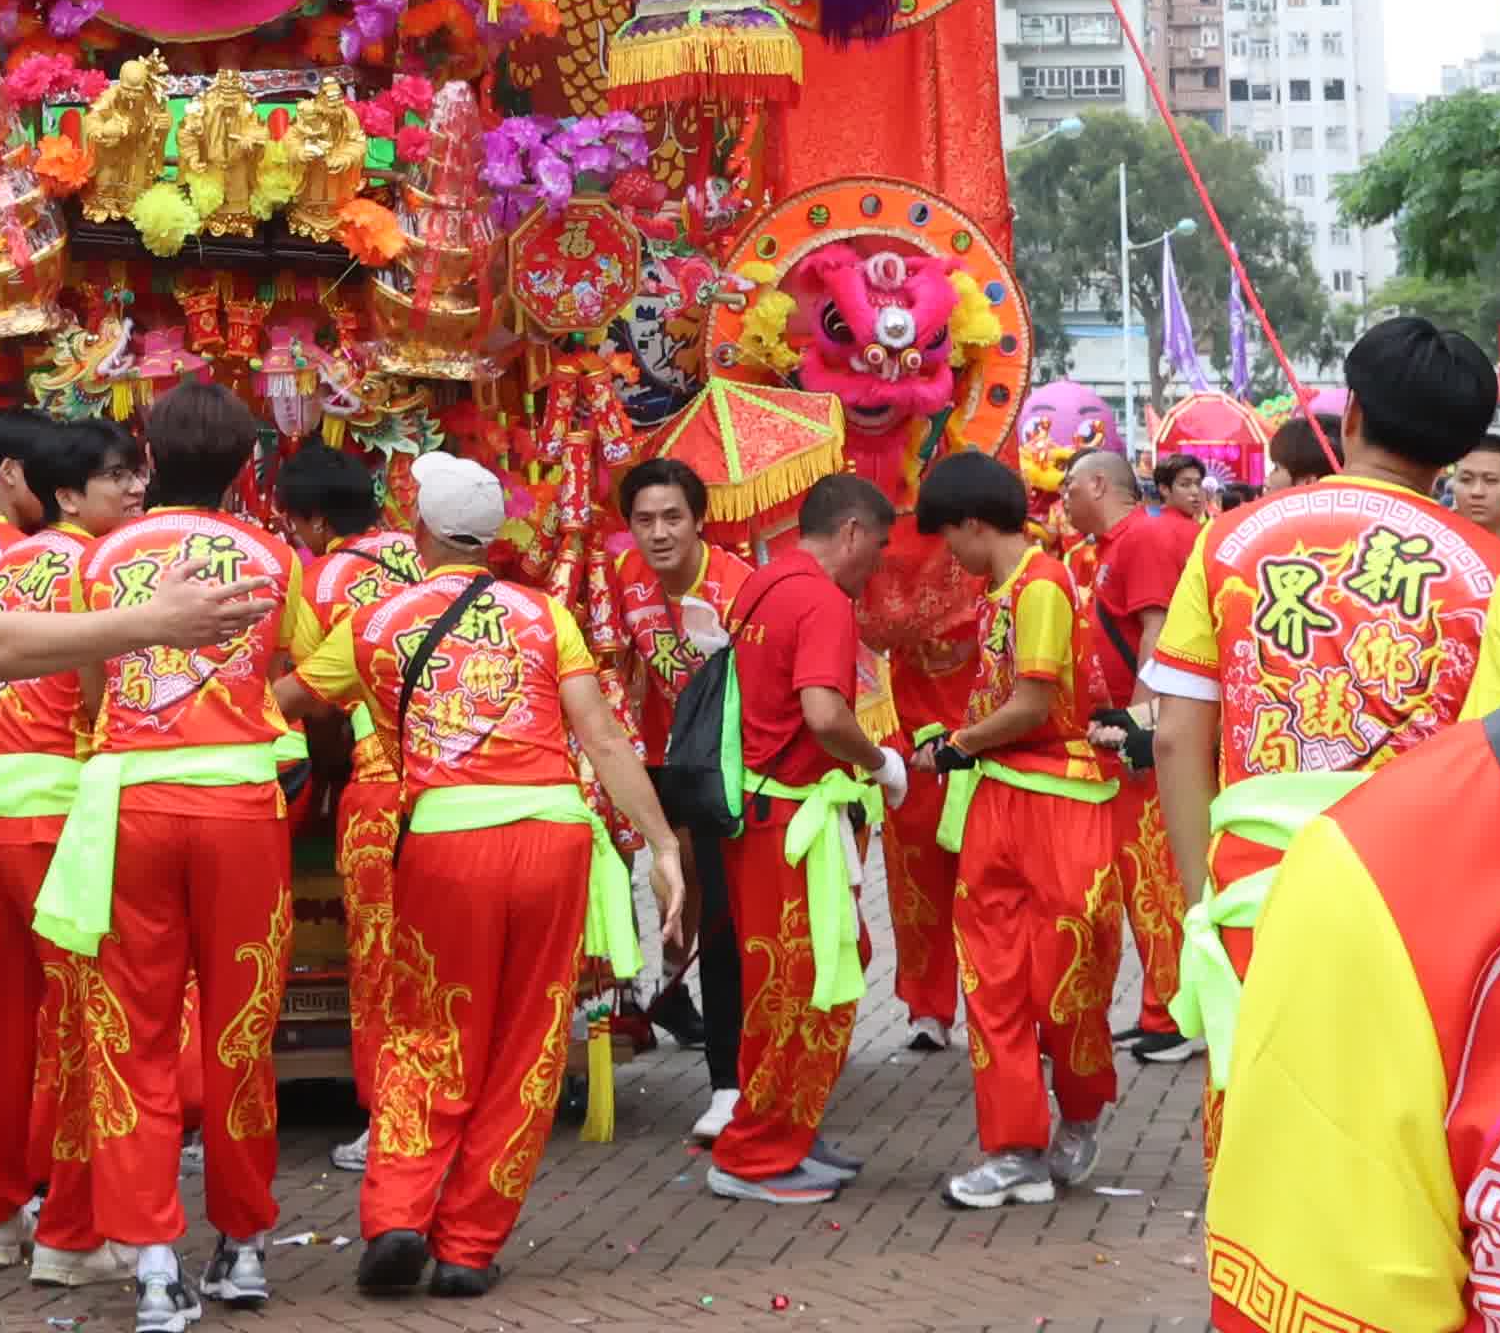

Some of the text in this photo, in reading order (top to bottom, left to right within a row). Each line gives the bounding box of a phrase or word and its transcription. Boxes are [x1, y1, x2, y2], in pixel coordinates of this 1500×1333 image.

[1256, 524, 1449, 661] 新界
[1246, 619, 1422, 773] 鄉議局
